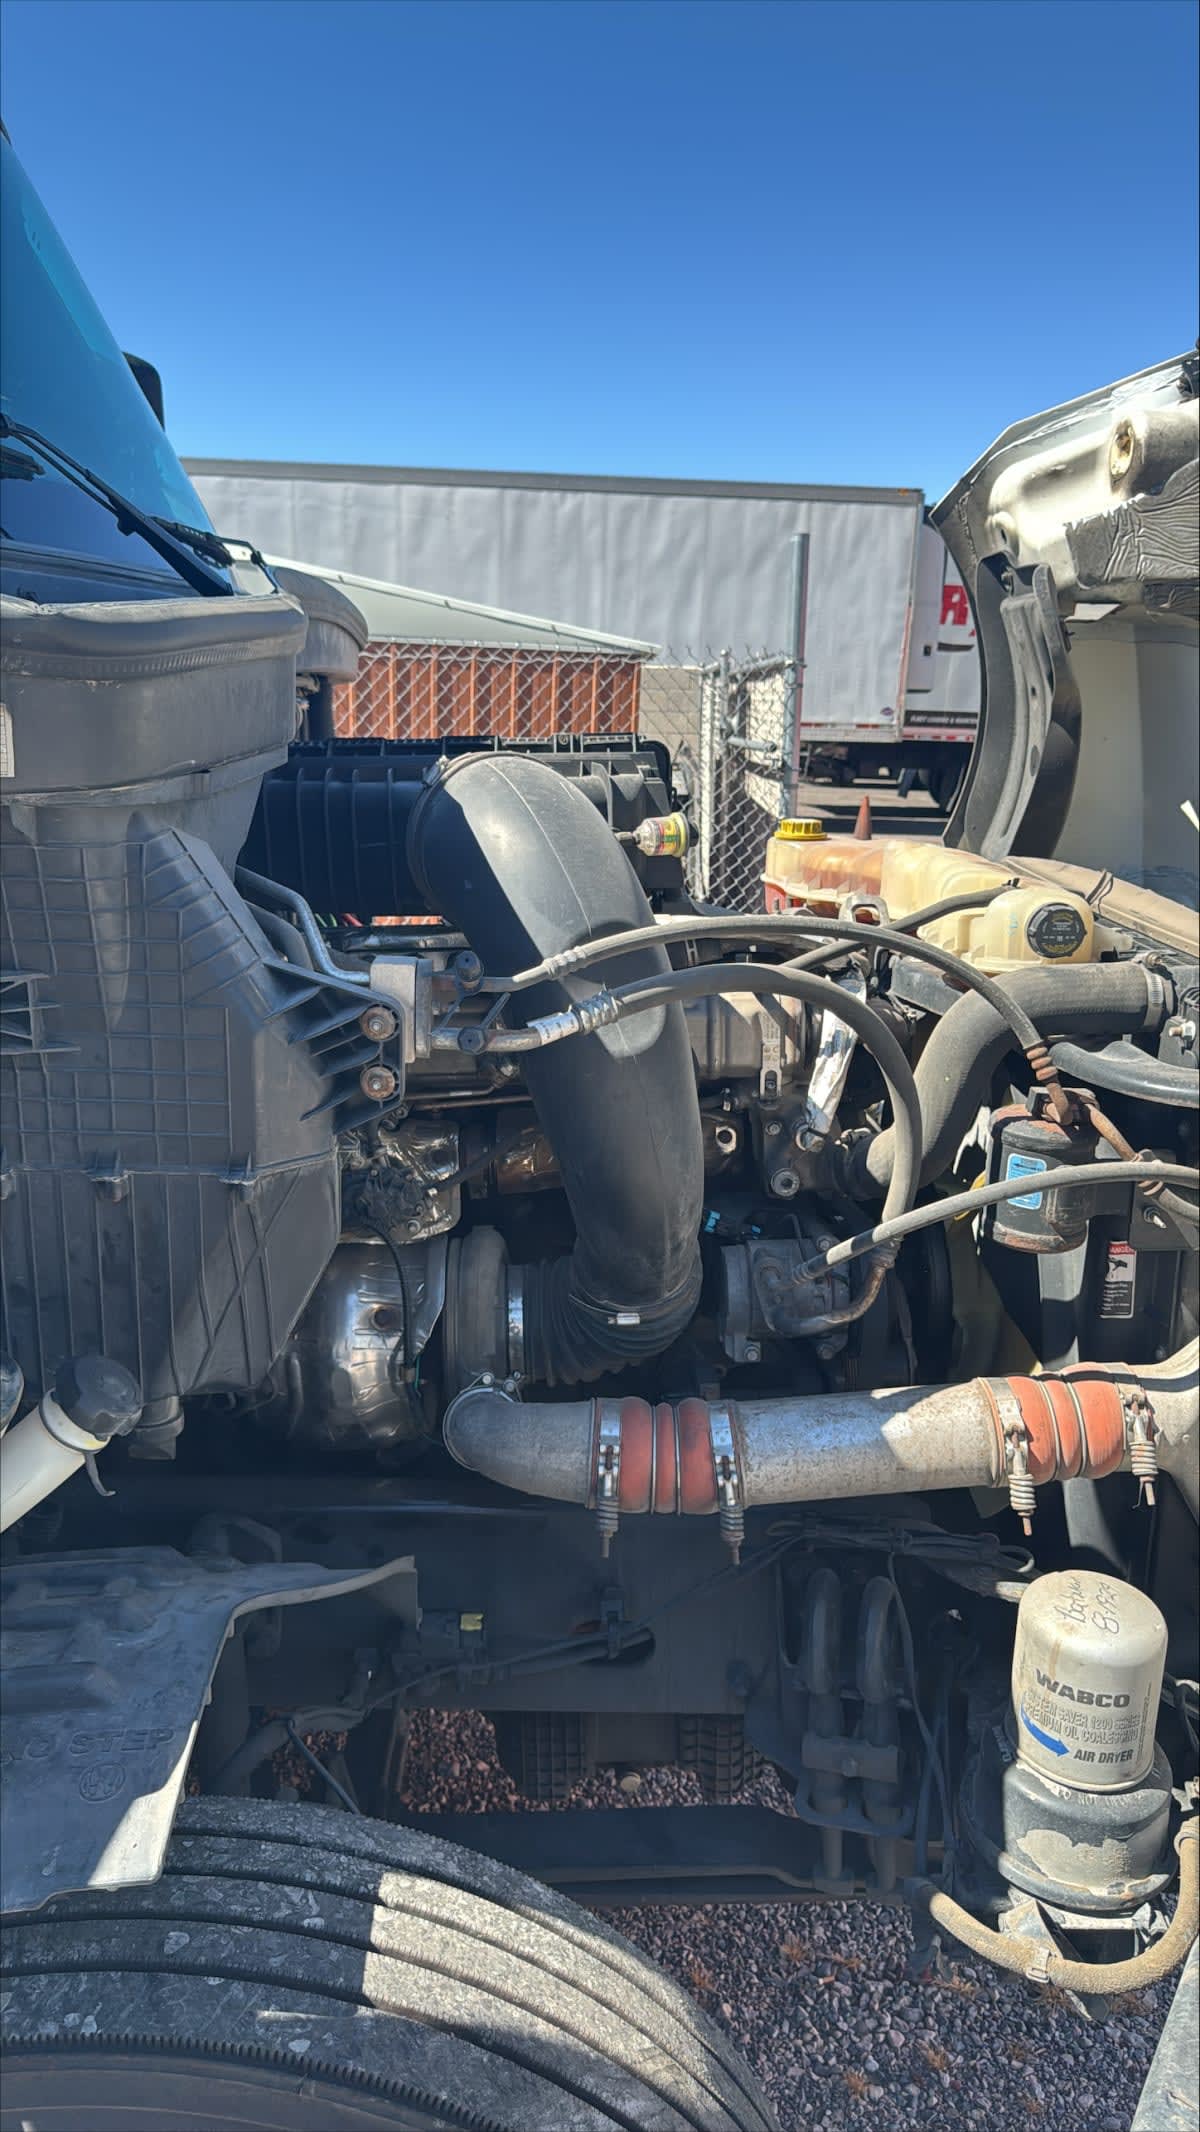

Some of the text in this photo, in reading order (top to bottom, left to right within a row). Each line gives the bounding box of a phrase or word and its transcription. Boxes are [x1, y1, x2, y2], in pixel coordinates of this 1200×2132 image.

[1036, 1668, 1130, 1708] WABCO
[1025, 1700, 1061, 1736] PREMIUM
[1064, 1725, 1080, 1741] OIL
[1059, 1707, 1088, 1729] SAVER
[1092, 1714, 1114, 1730] 1200
[69, 1728, 175, 1756] STEP
[1073, 1749, 1134, 1764] AIR DRYER
